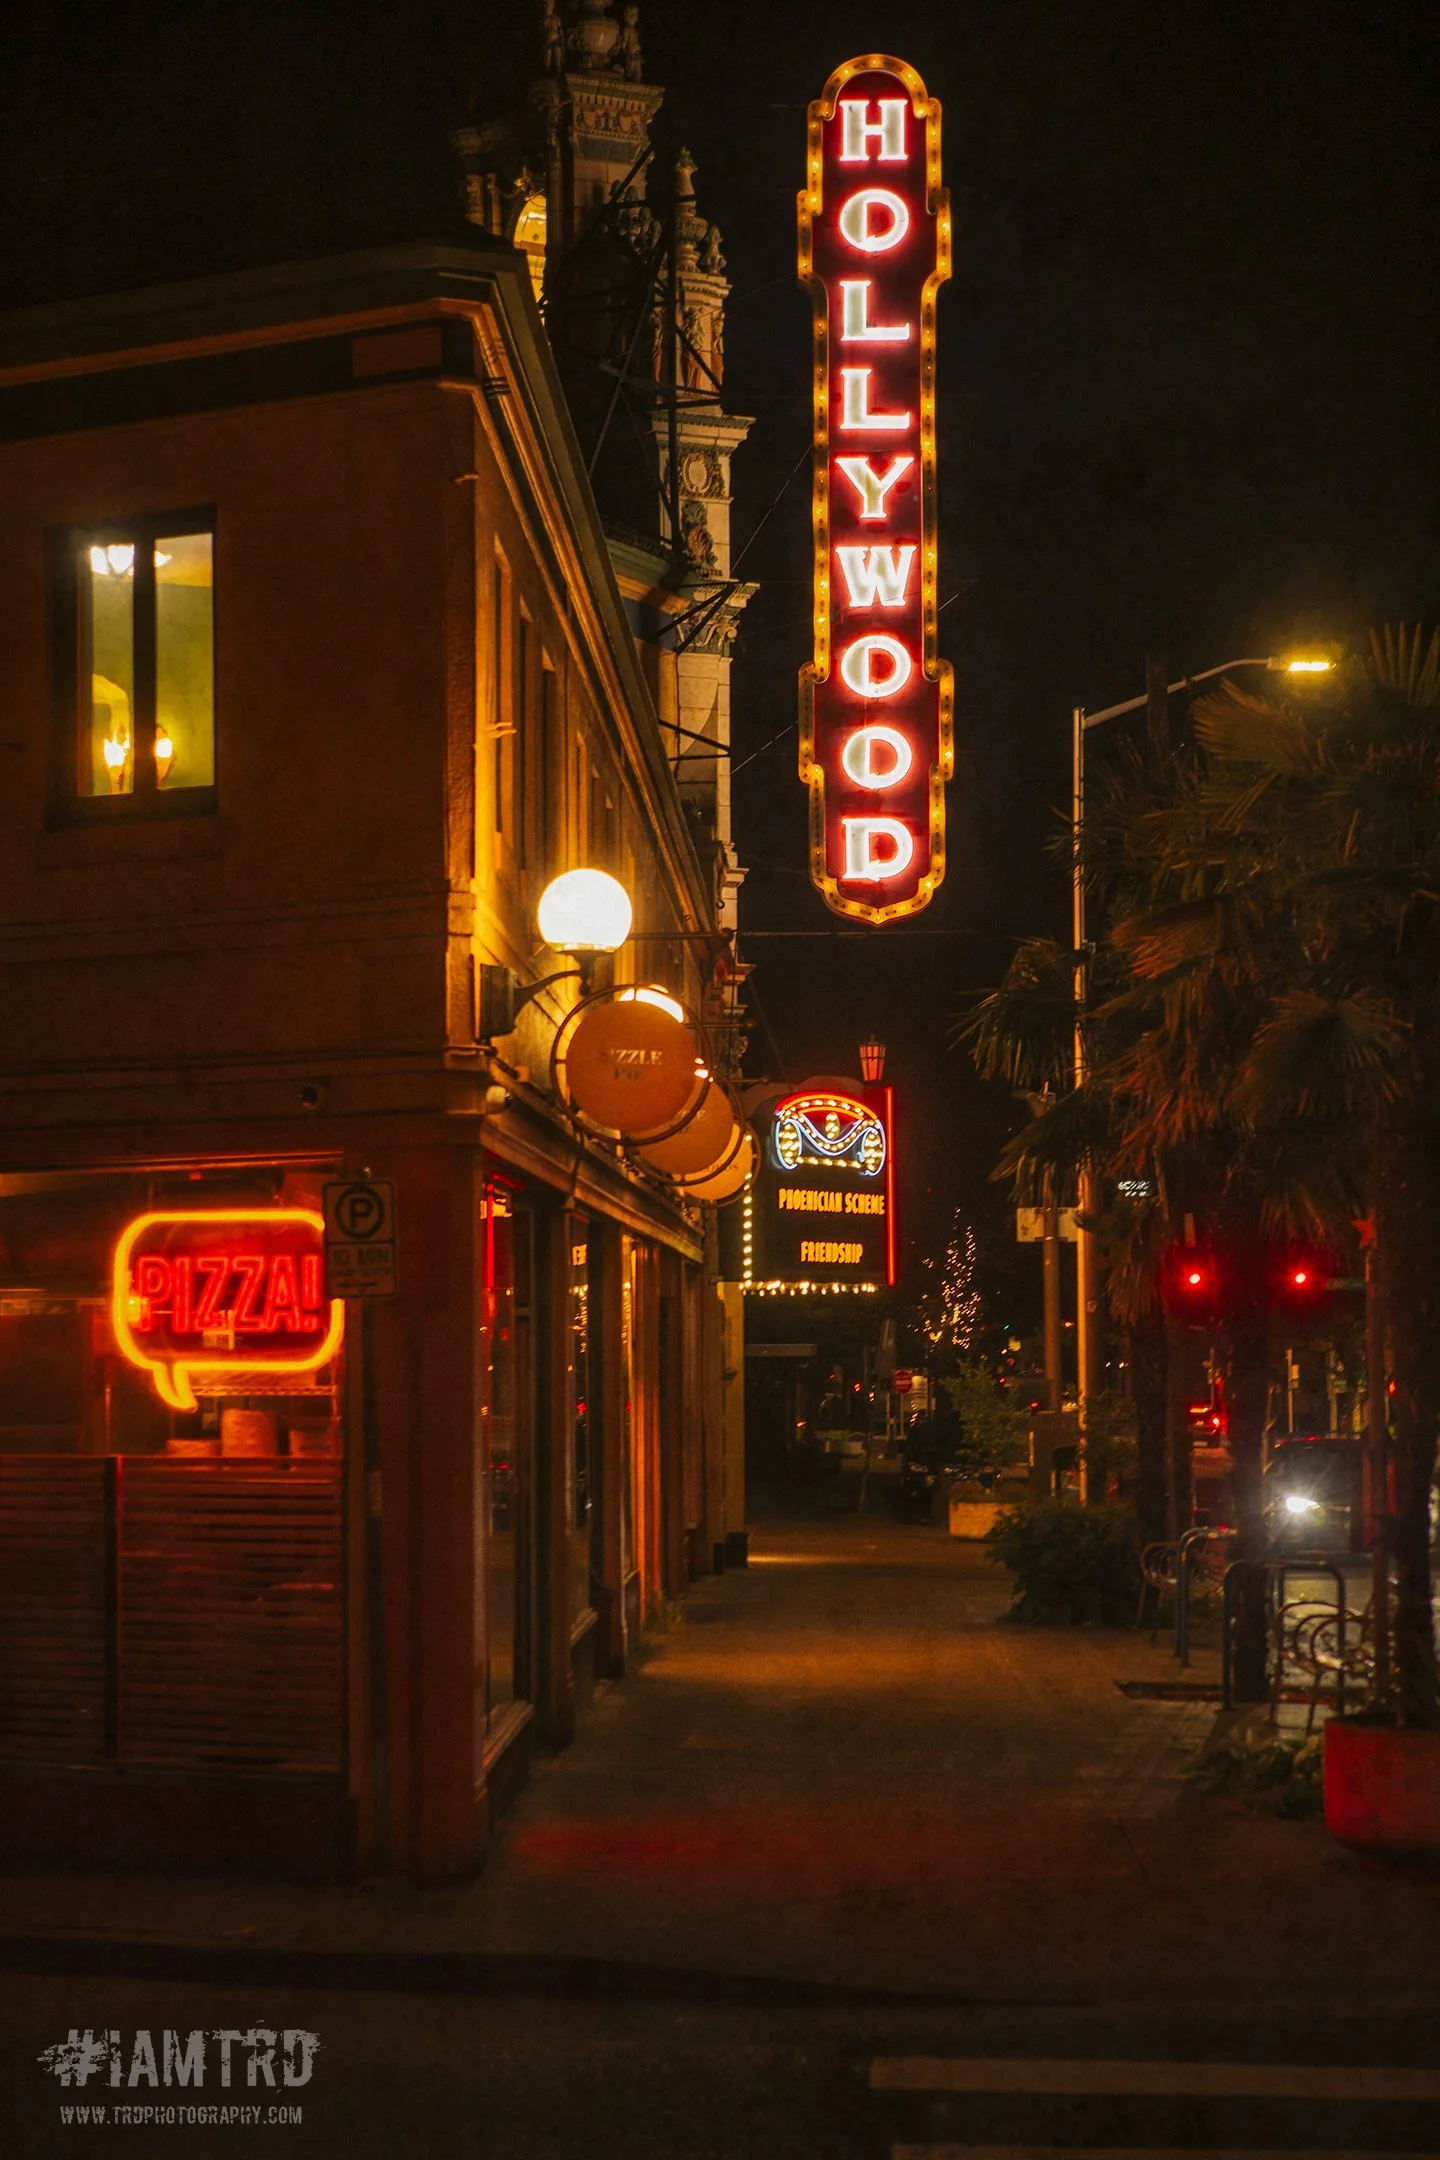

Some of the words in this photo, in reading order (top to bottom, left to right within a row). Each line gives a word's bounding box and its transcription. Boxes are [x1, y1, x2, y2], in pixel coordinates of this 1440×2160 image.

[836, 98, 917, 881] HOLLYWOOD
[779, 1188, 843, 1212] PHOENICIAN
[845, 1192, 885, 1215] SCHEME
[801, 1241, 863, 1264] FRIENDSHIP
[136, 1254, 322, 1333] PIZZA!
